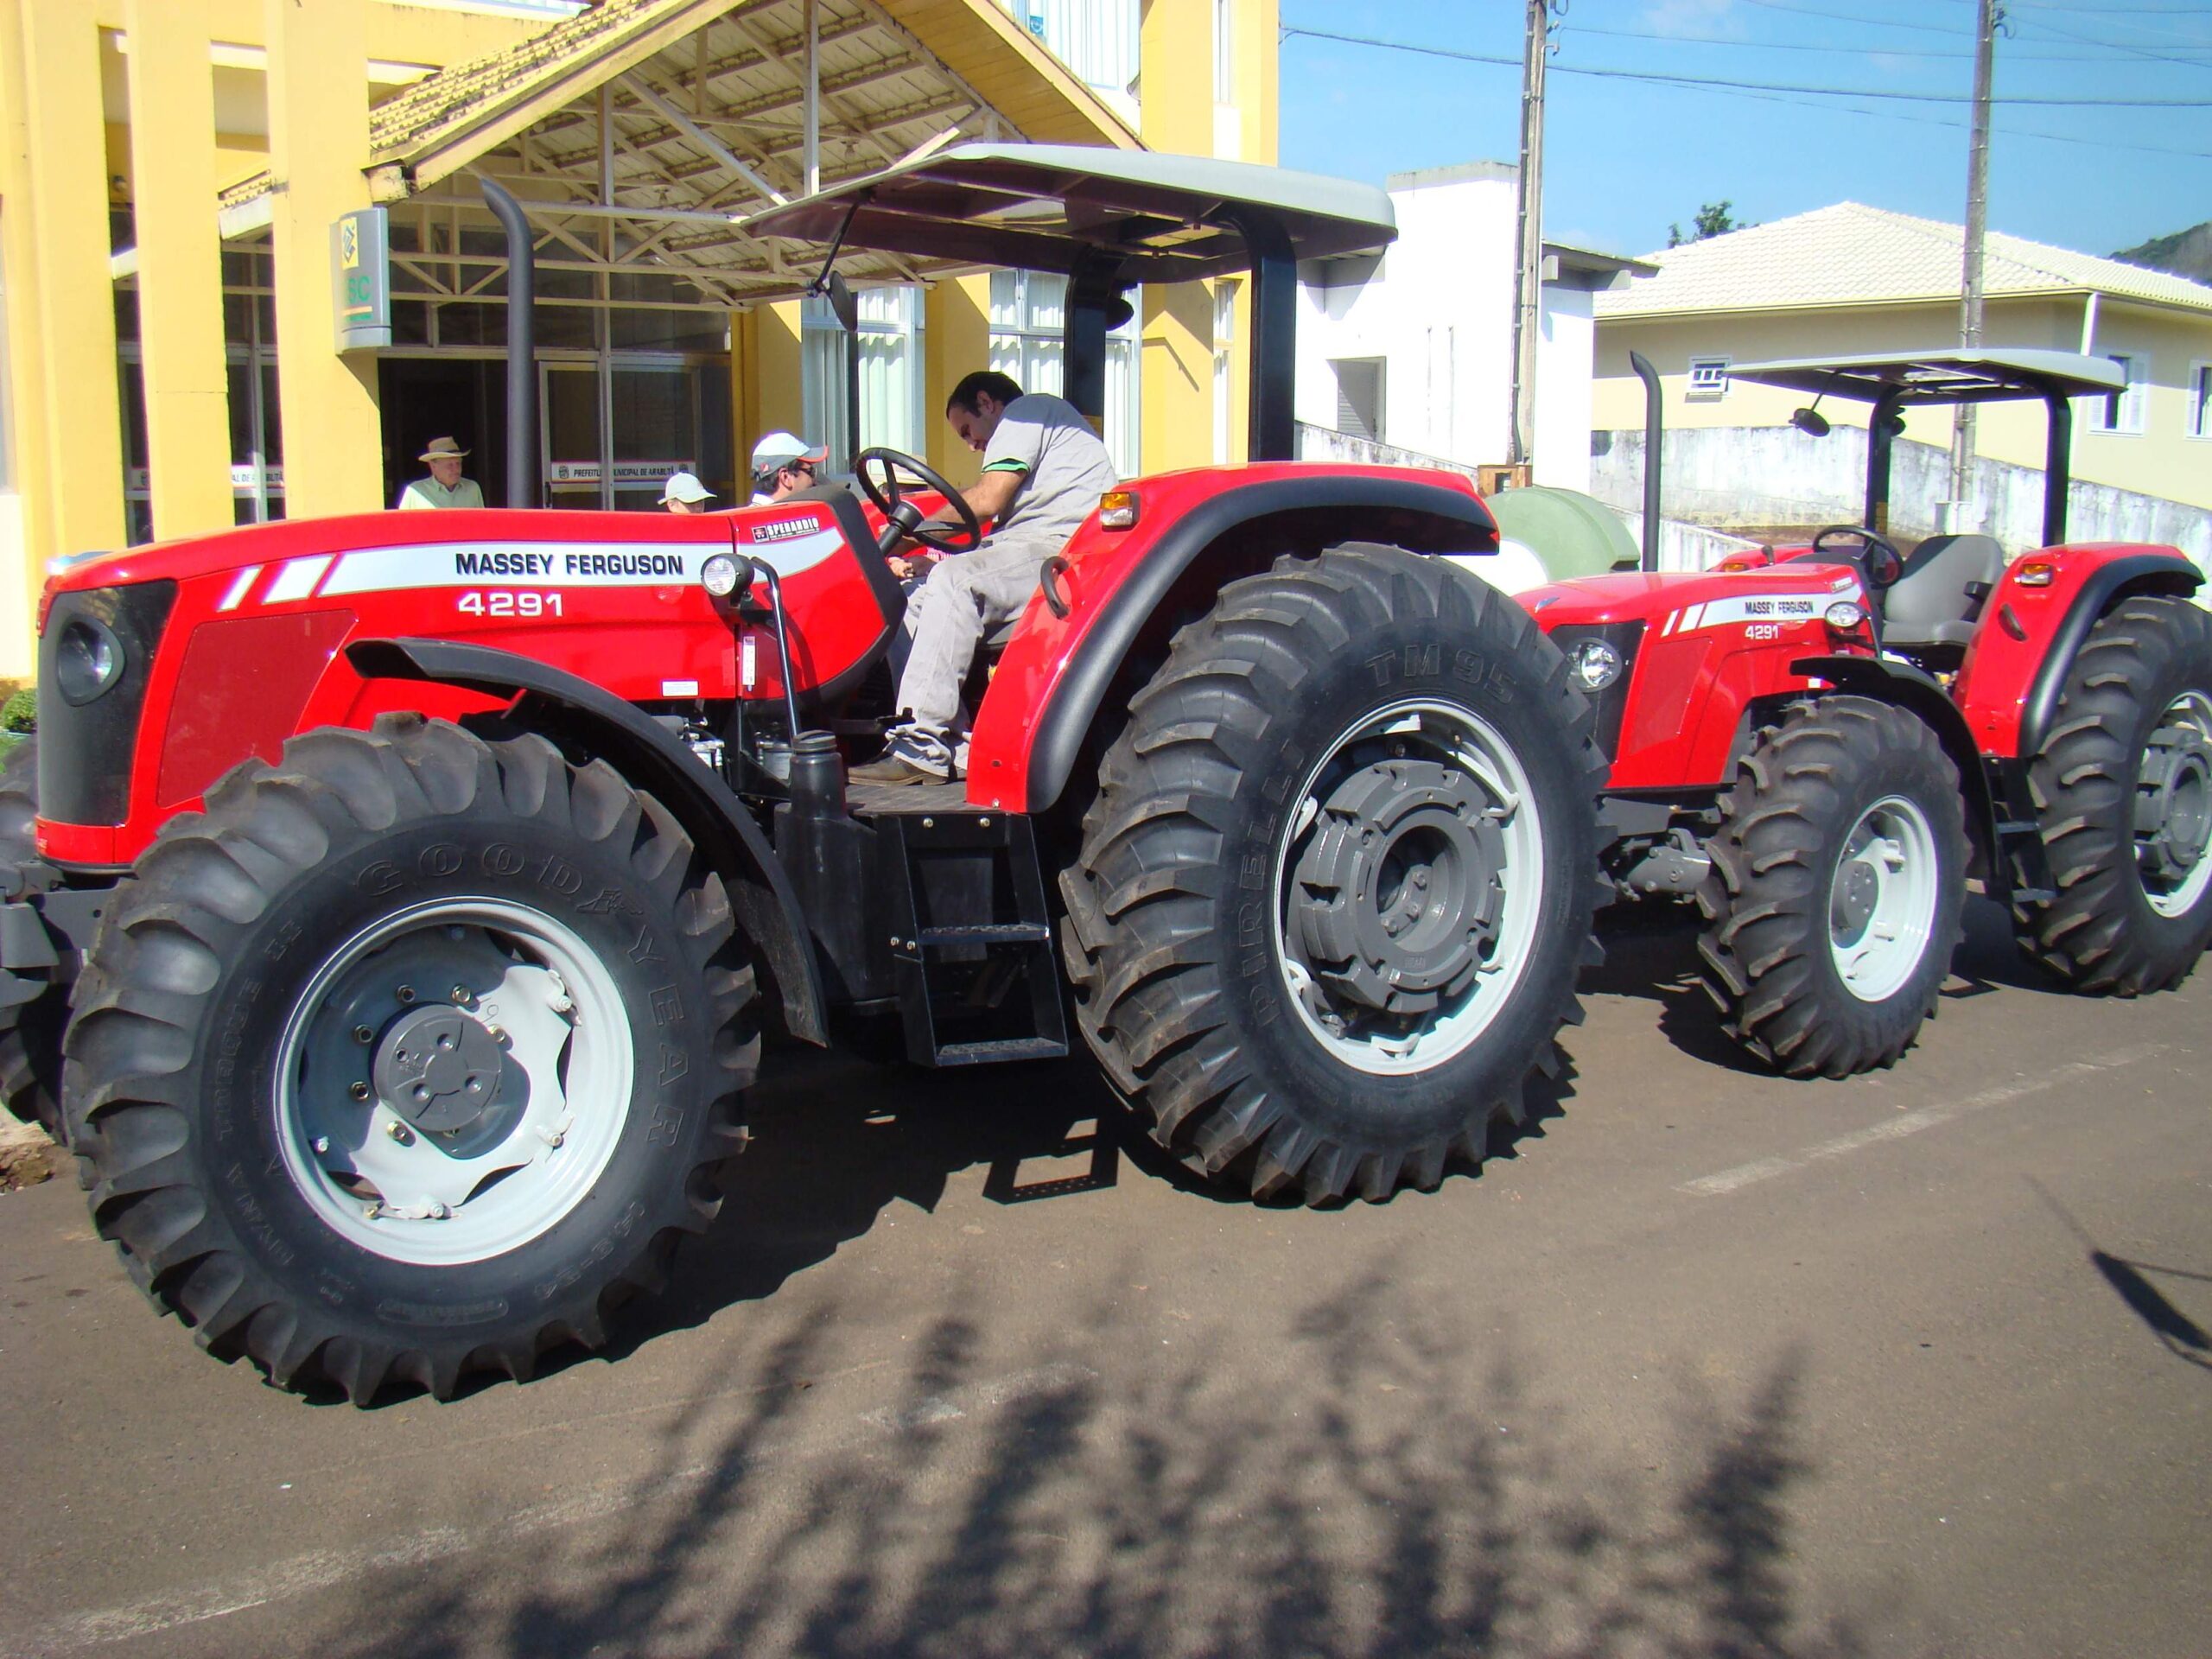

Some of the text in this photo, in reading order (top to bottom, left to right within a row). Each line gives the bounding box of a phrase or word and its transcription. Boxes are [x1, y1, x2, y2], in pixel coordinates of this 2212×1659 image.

[574, 468, 601, 477] PREFEITU
[456, 553, 683, 575] MASSEY FERGUSON
[458, 593, 563, 617] 4291
[1745, 601, 1814, 614] MASSEY FERGUSON
[1745, 625, 1779, 639] 4291
[1239, 737, 1306, 1027] PIRELLI
